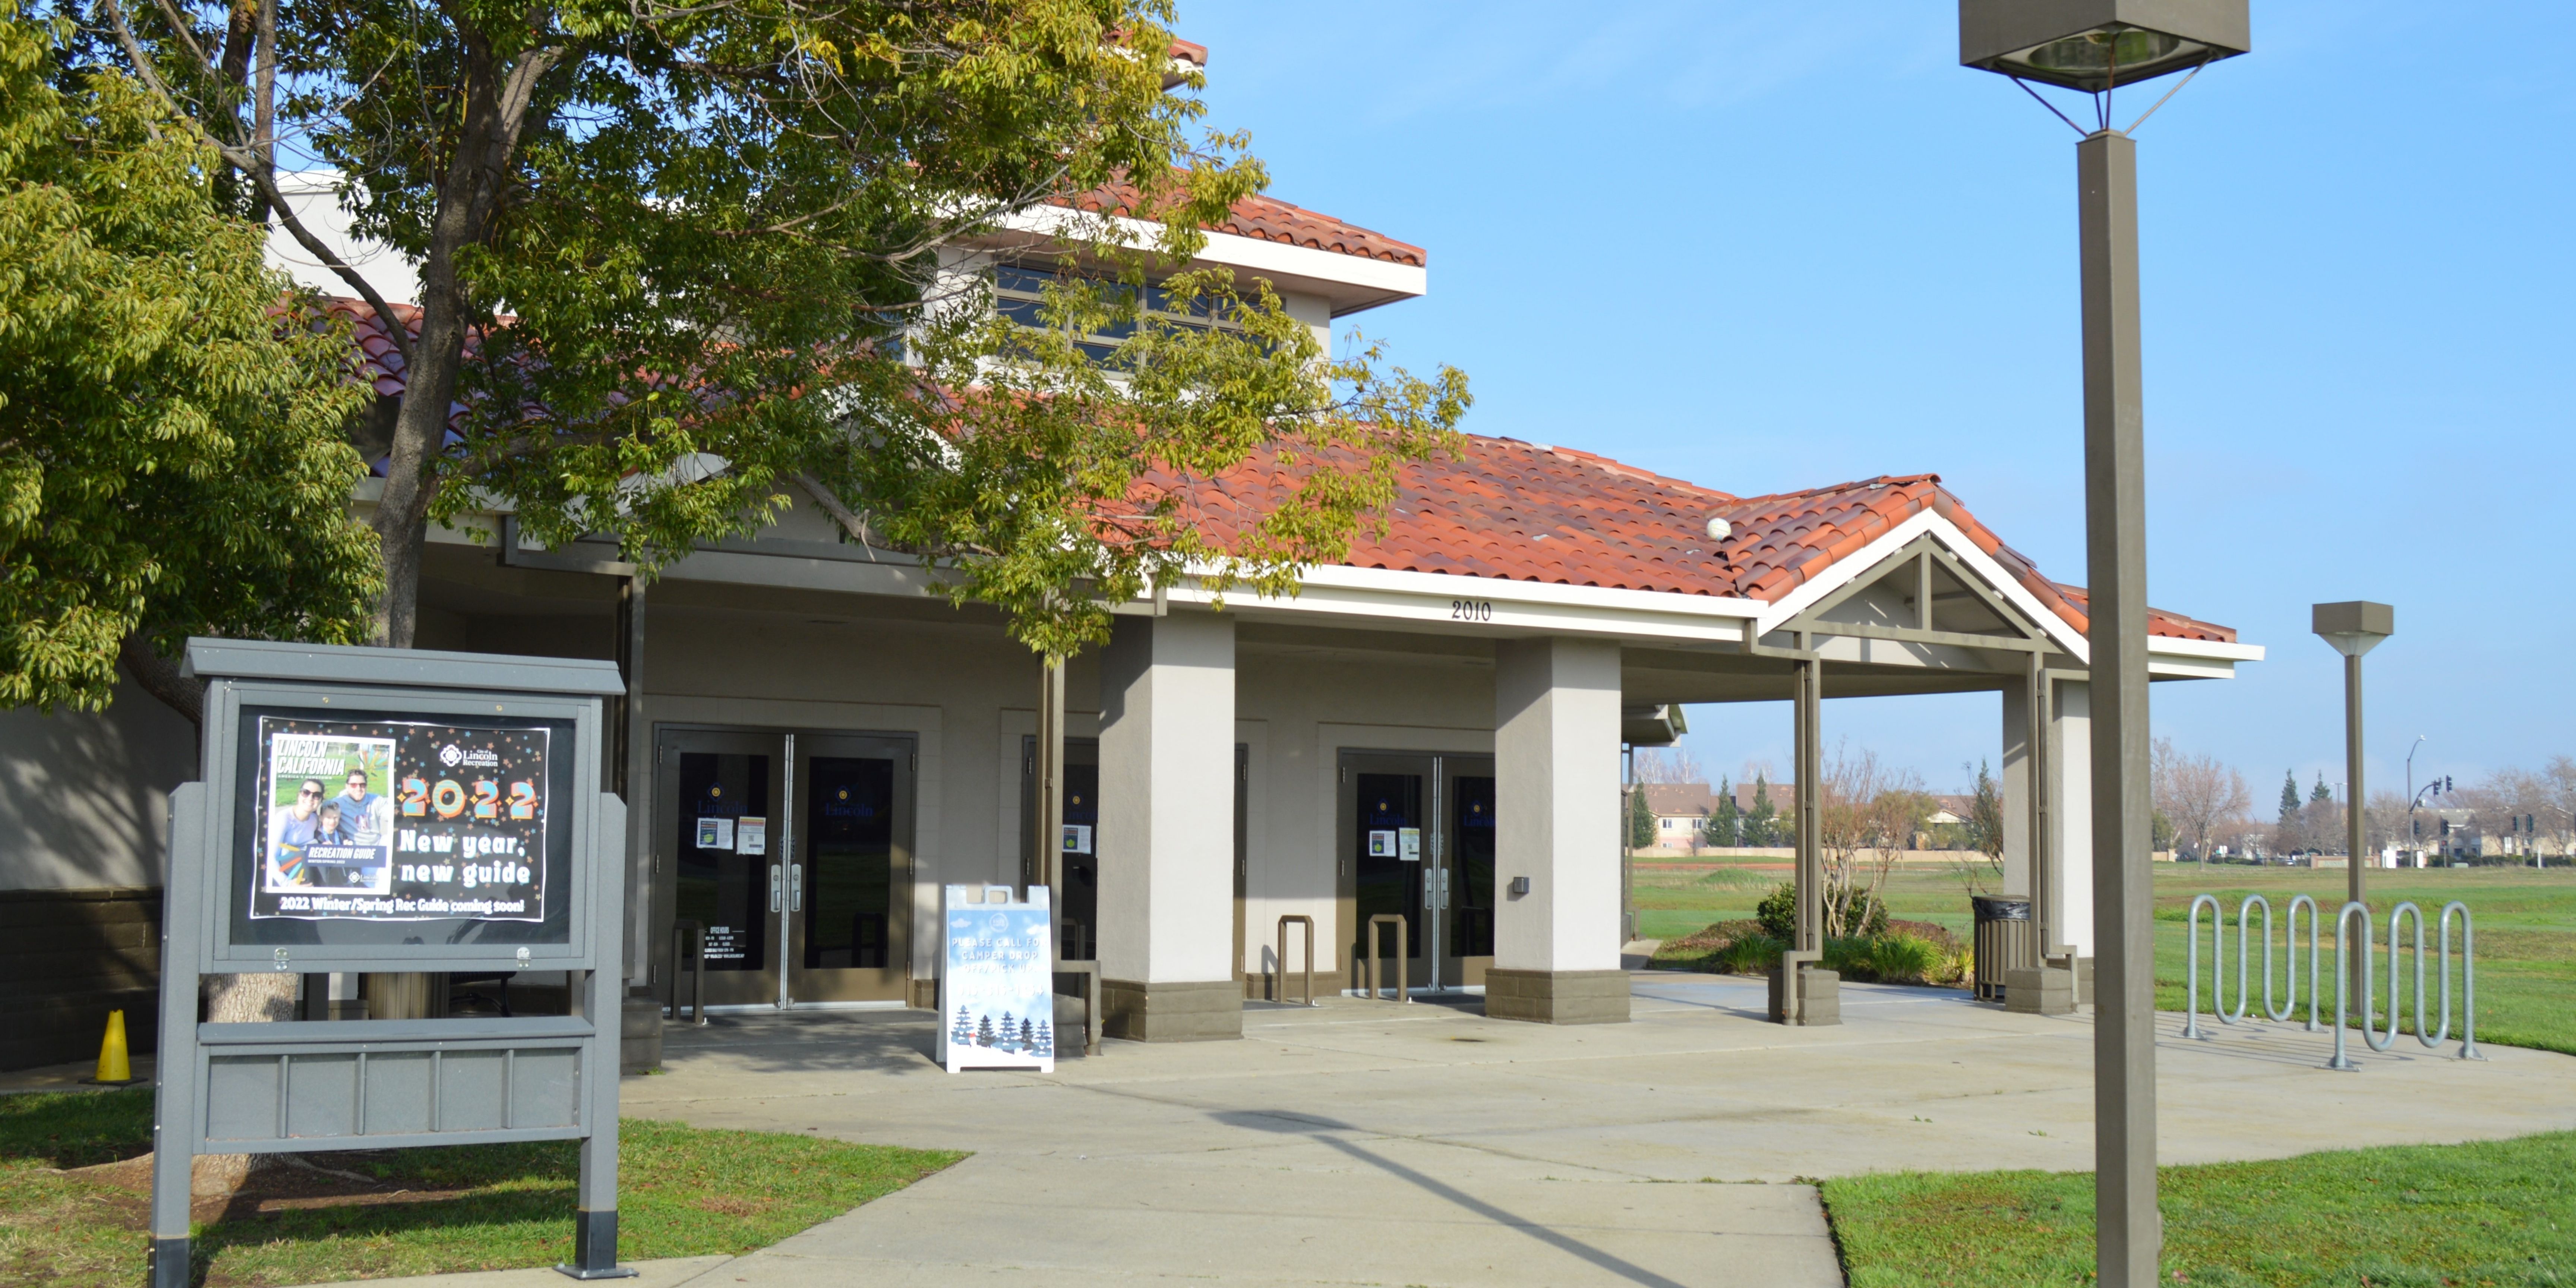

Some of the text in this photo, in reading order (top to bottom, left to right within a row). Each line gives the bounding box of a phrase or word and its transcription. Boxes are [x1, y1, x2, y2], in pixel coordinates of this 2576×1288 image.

[1452, 600, 1491, 621] 2010
[278, 740, 328, 758] LINCOLN
[463, 750, 498, 760] Lincoln
[277, 757, 345, 776] CALIFORNIA
[402, 779, 536, 819] 2022
[825, 802, 874, 817] Lincoln
[1369, 813, 1407, 825] Lincoln
[400, 830, 525, 858] New year,
[309, 847, 376, 859] RECREATION GUIDE
[401, 860, 531, 888] new guide
[280, 897, 525, 914] 2022 Winter/Spring Rec Guide coming soon!
[952, 938, 992, 947] PLEASE
[996, 938, 1022, 947] CALL
[962, 951, 1038, 961] CAMPER DROP
